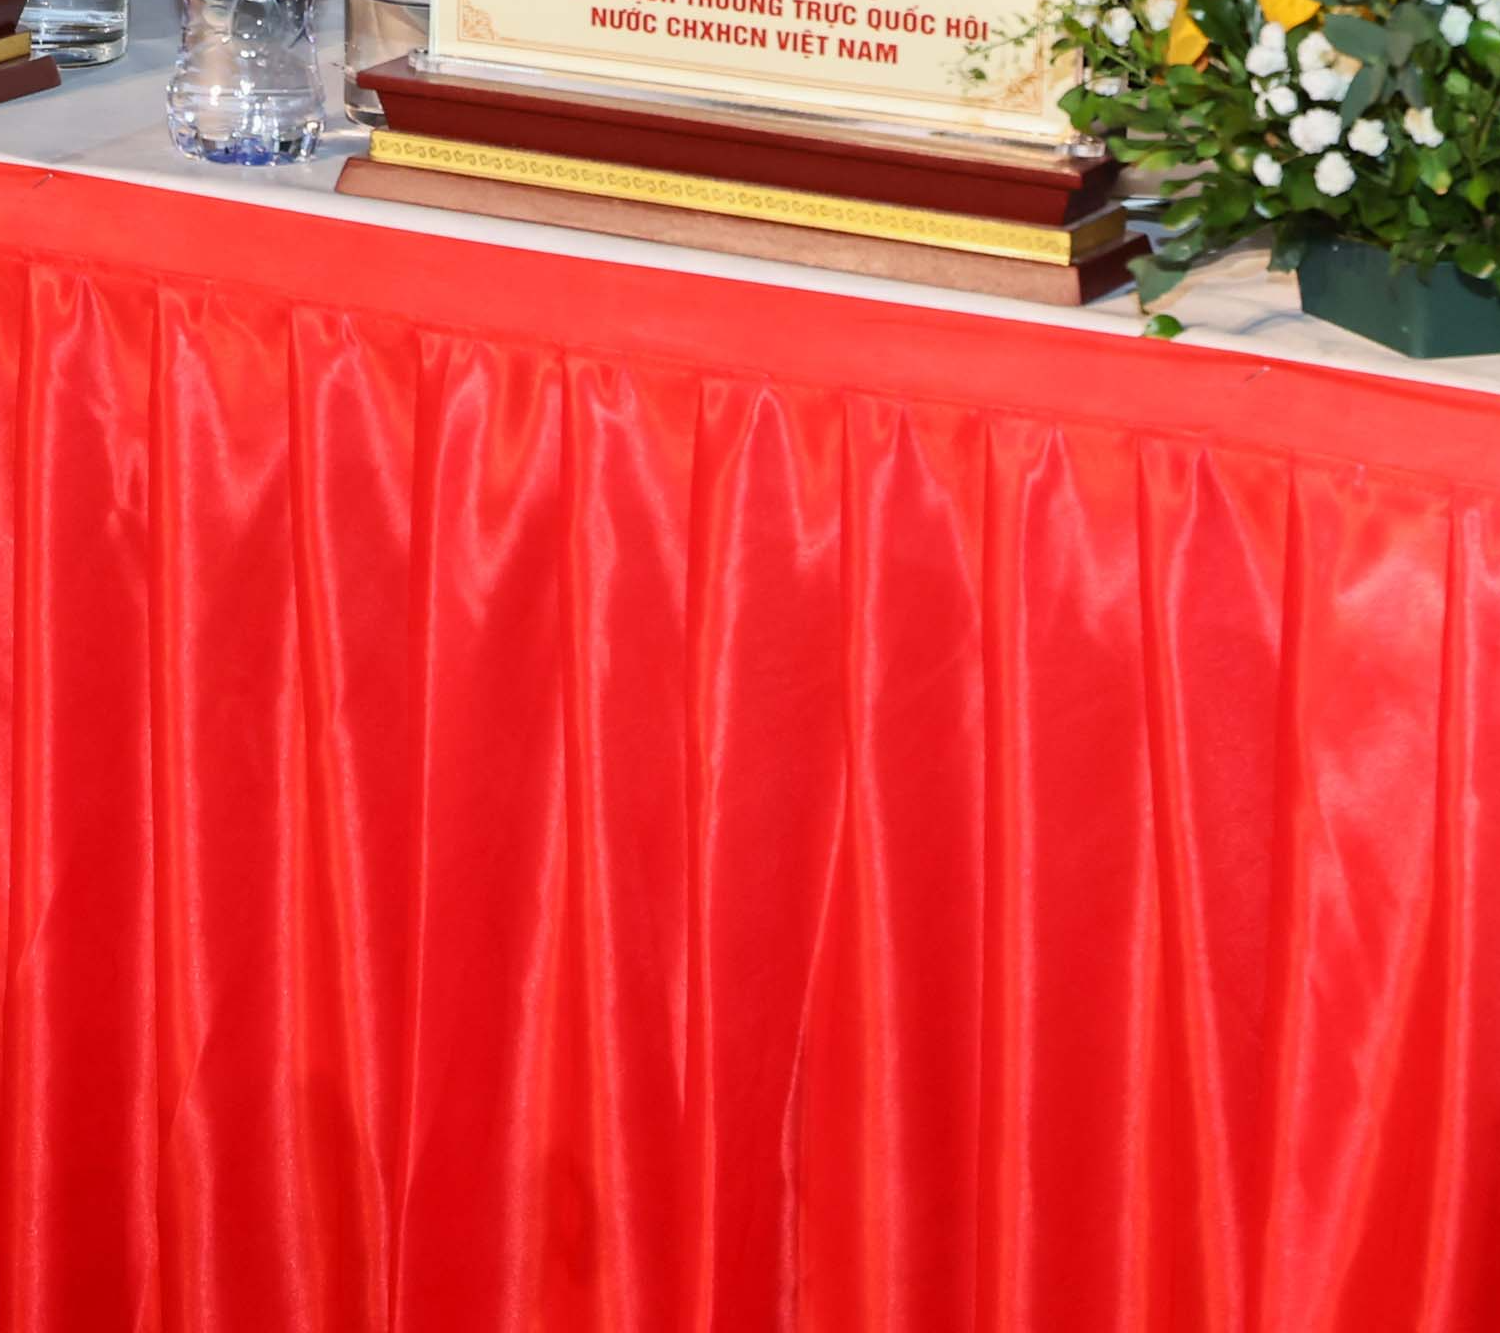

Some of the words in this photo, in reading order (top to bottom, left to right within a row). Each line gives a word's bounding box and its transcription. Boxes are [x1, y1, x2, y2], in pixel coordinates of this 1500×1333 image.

[591, 6, 657, 34] NƯỚC
[666, 16, 767, 48] CHXHCN
[777, 29, 829, 59] VIỆT
[838, 38, 898, 64] NAM
[867, 5, 935, 35] QUỐC
[946, 15, 988, 46] HỘI
